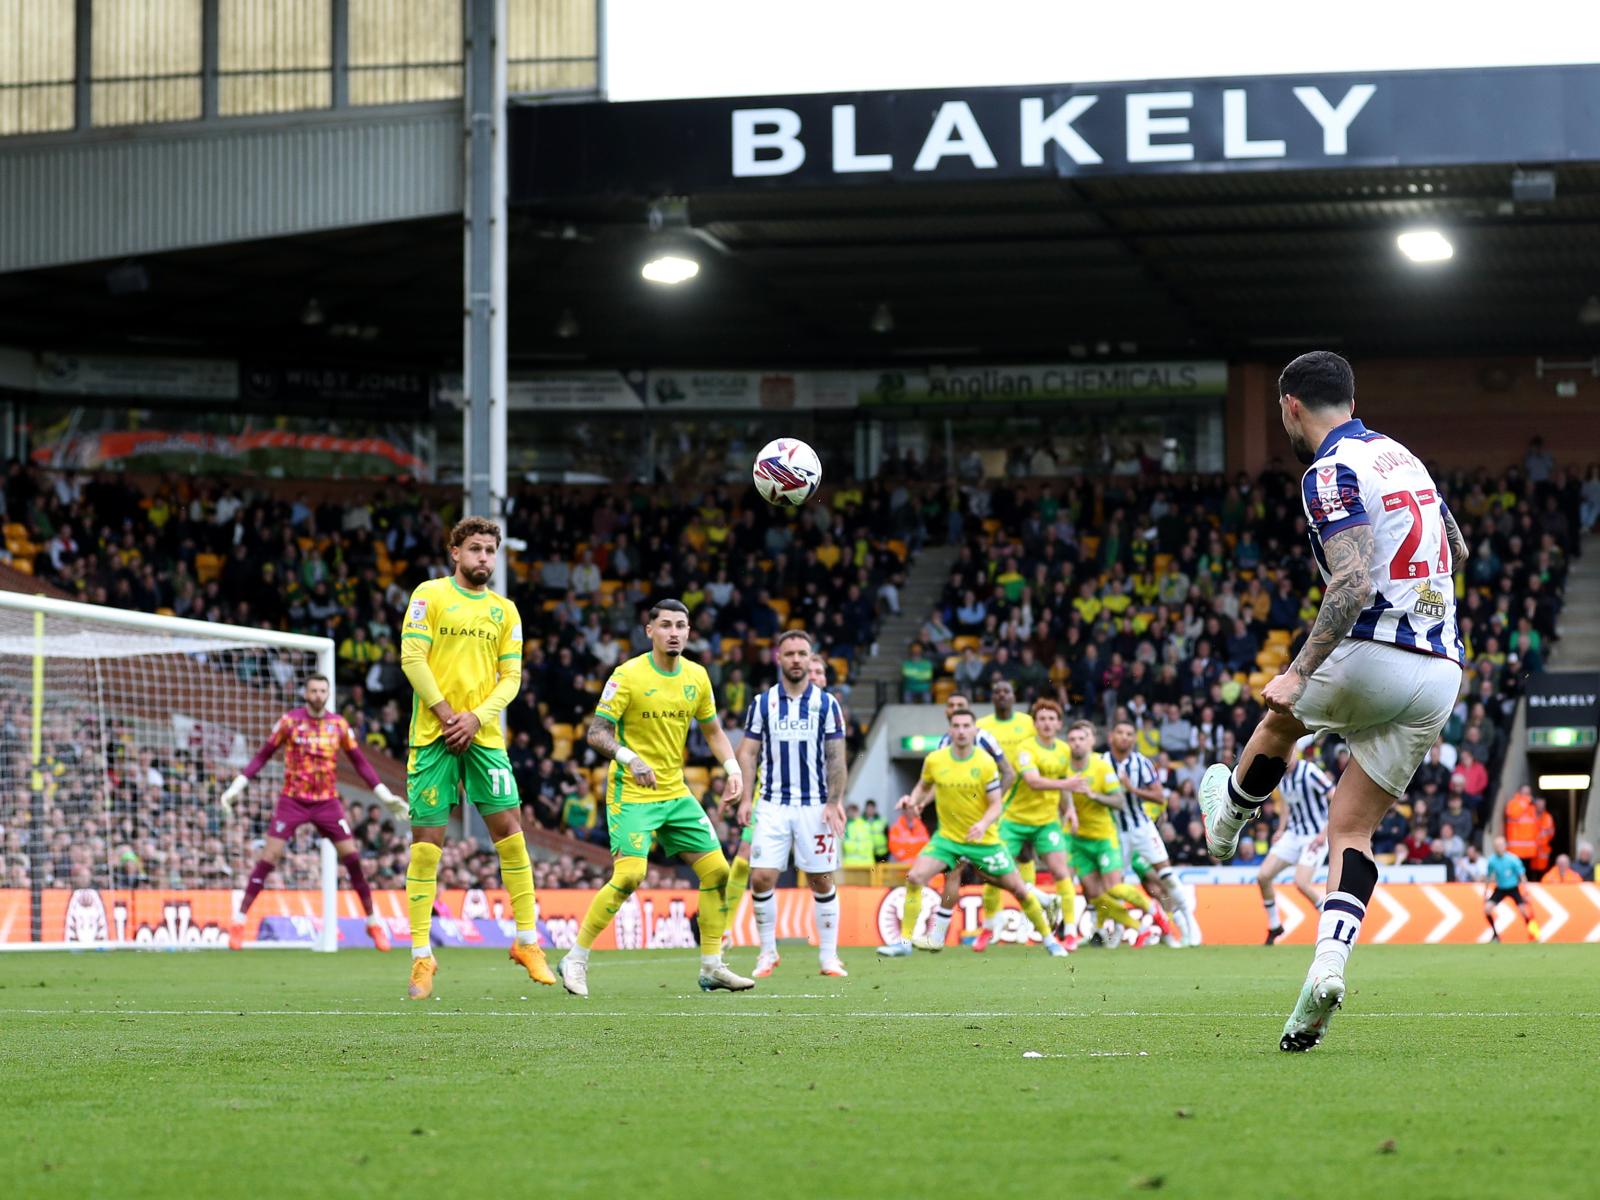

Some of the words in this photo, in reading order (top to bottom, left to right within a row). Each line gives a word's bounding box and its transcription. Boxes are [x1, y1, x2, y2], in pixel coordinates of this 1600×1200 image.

[731, 84, 1377, 178] BLAKELY
[929, 370, 1033, 399] Anglian
[1043, 367, 1197, 394] CHEMICALS
[1382, 489, 1449, 581] 27
[1529, 694, 1597, 708] BLAKELY
[774, 715, 814, 731] ideal
[488, 768, 512, 796] 11
